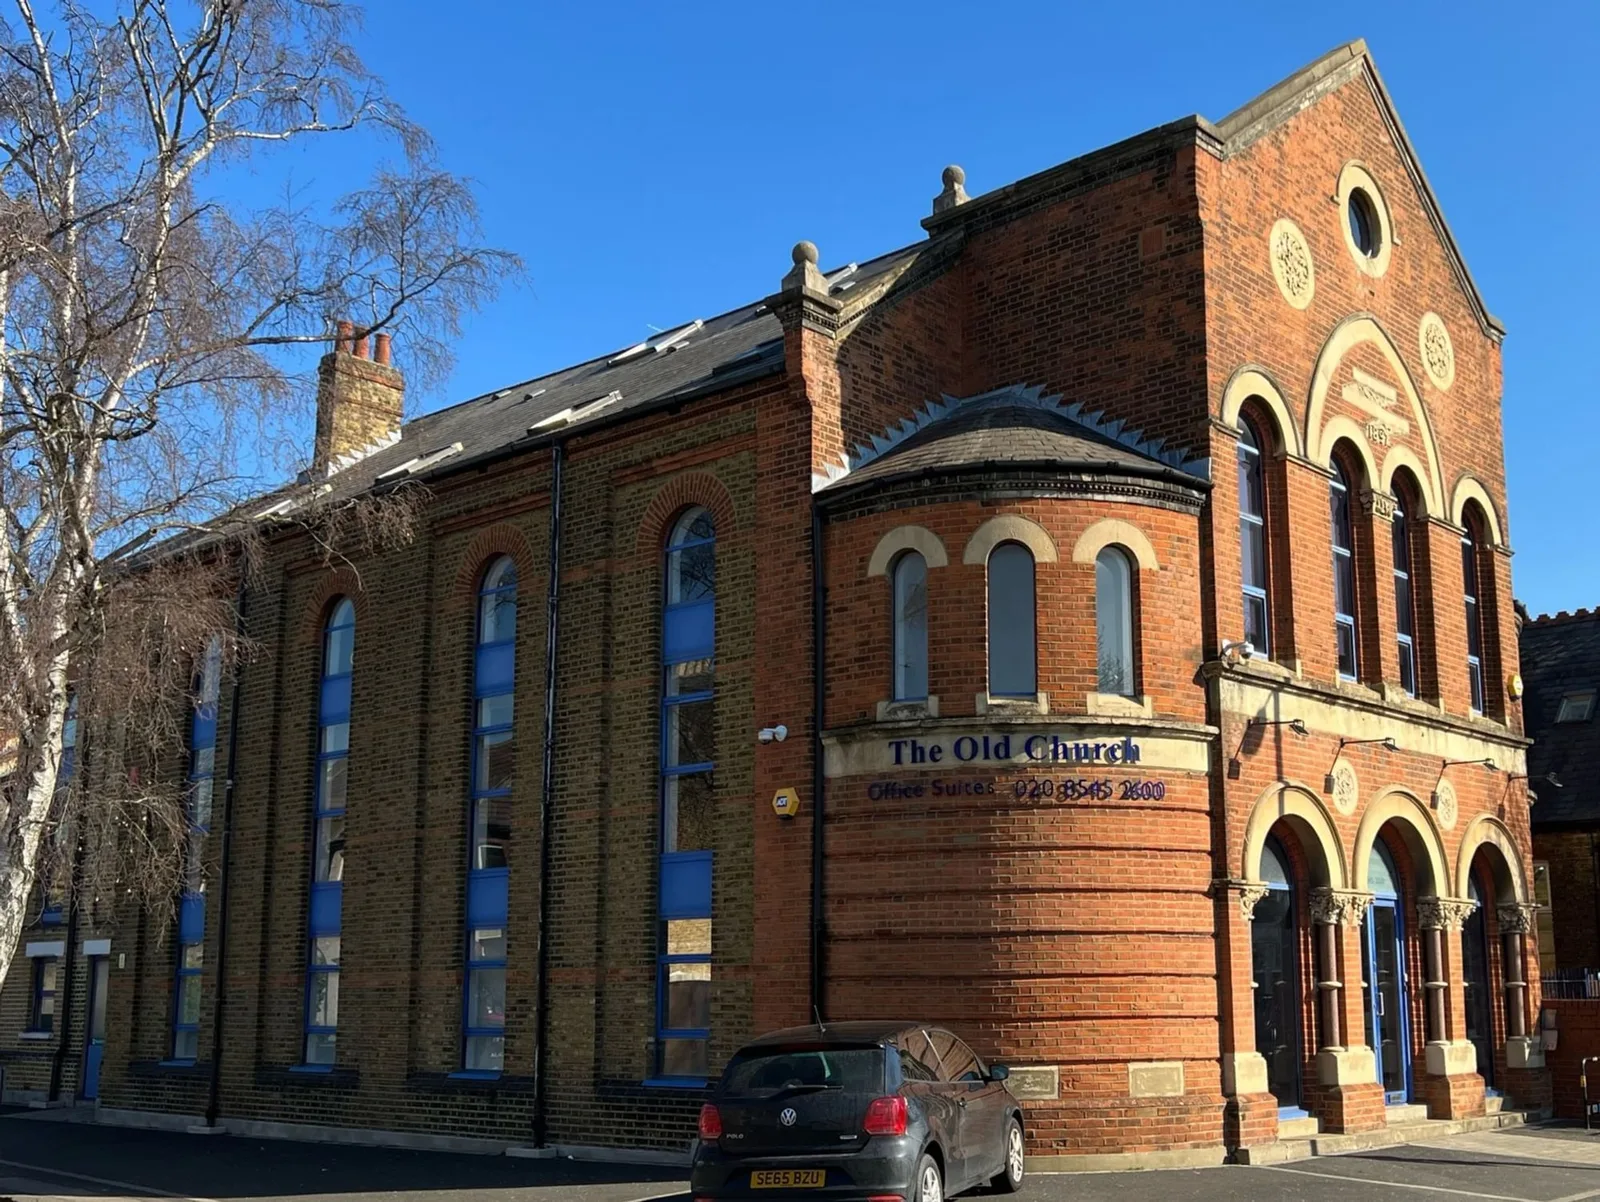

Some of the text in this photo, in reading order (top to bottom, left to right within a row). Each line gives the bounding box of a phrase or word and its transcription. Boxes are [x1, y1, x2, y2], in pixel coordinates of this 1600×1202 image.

[888, 735, 1140, 765] The Old Church
[868, 779, 1165, 800] Office Suites 020 8545 2600
[757, 1171, 819, 1185] SE65 BZU
